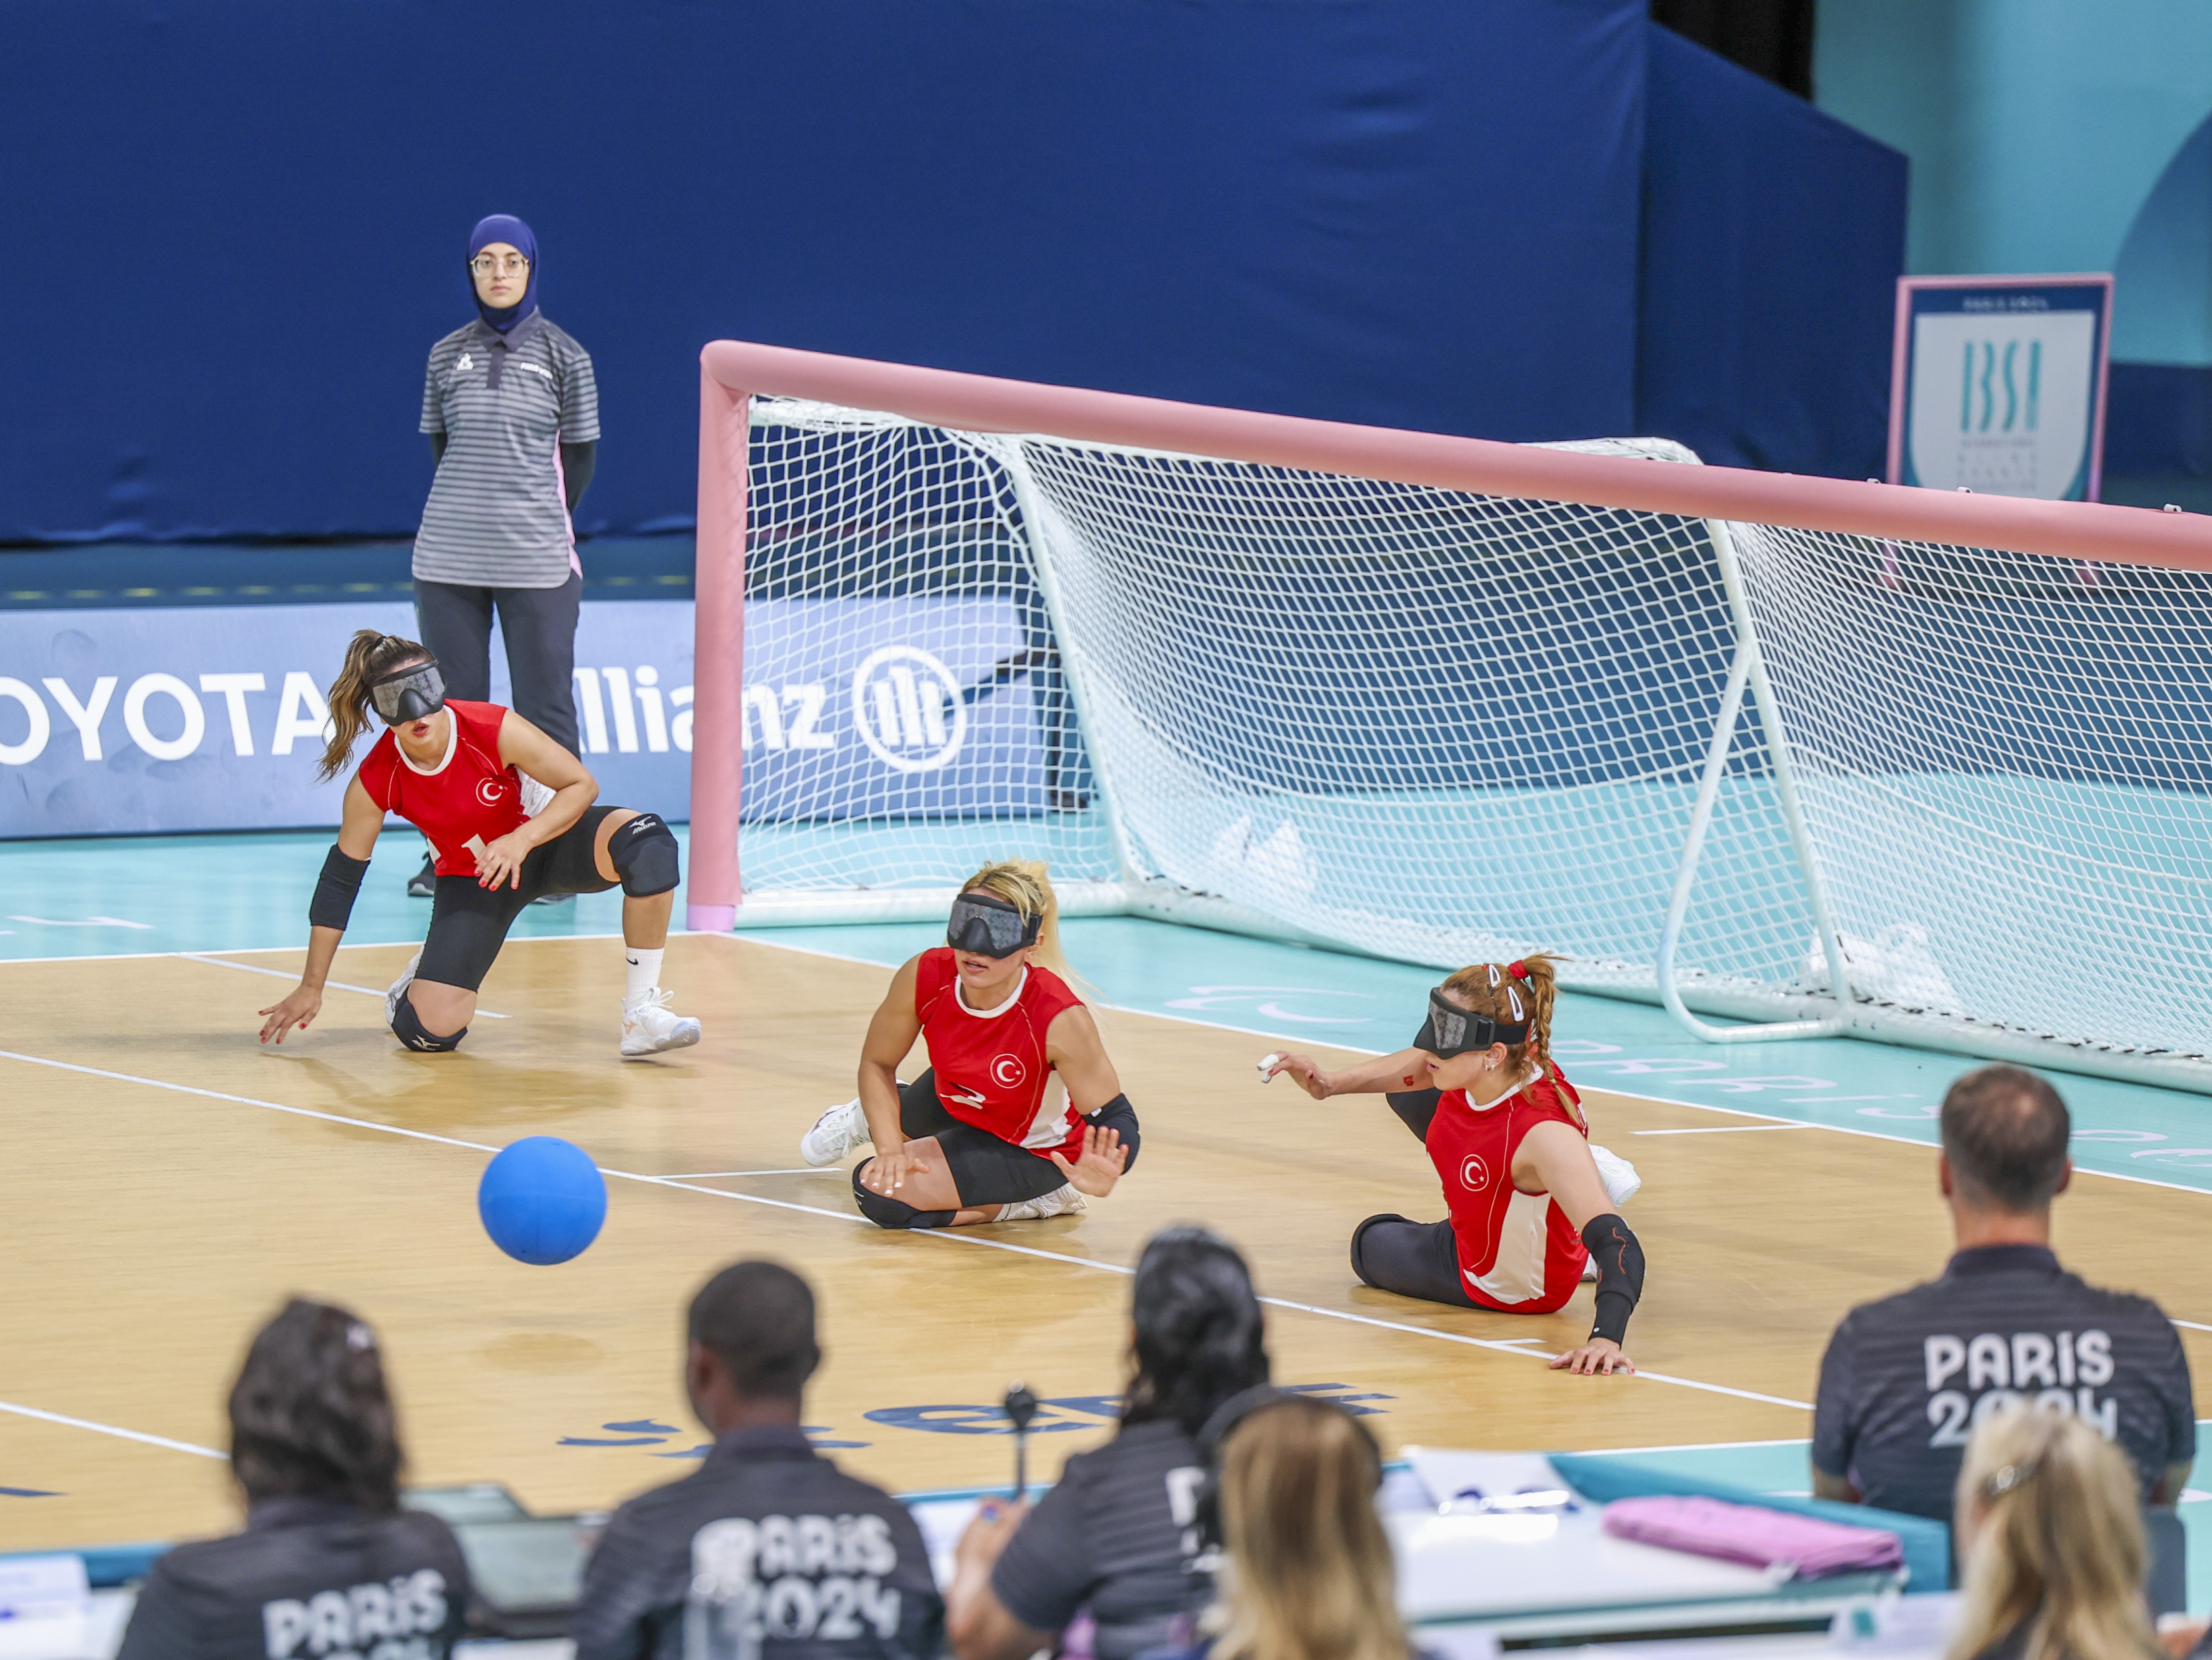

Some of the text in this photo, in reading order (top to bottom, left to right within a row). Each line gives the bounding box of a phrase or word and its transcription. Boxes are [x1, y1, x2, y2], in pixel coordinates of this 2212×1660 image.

[572, 665, 835, 753] llianz
[1924, 1329, 2115, 1391] PARIS
[262, 1568, 449, 1659] PARIS
